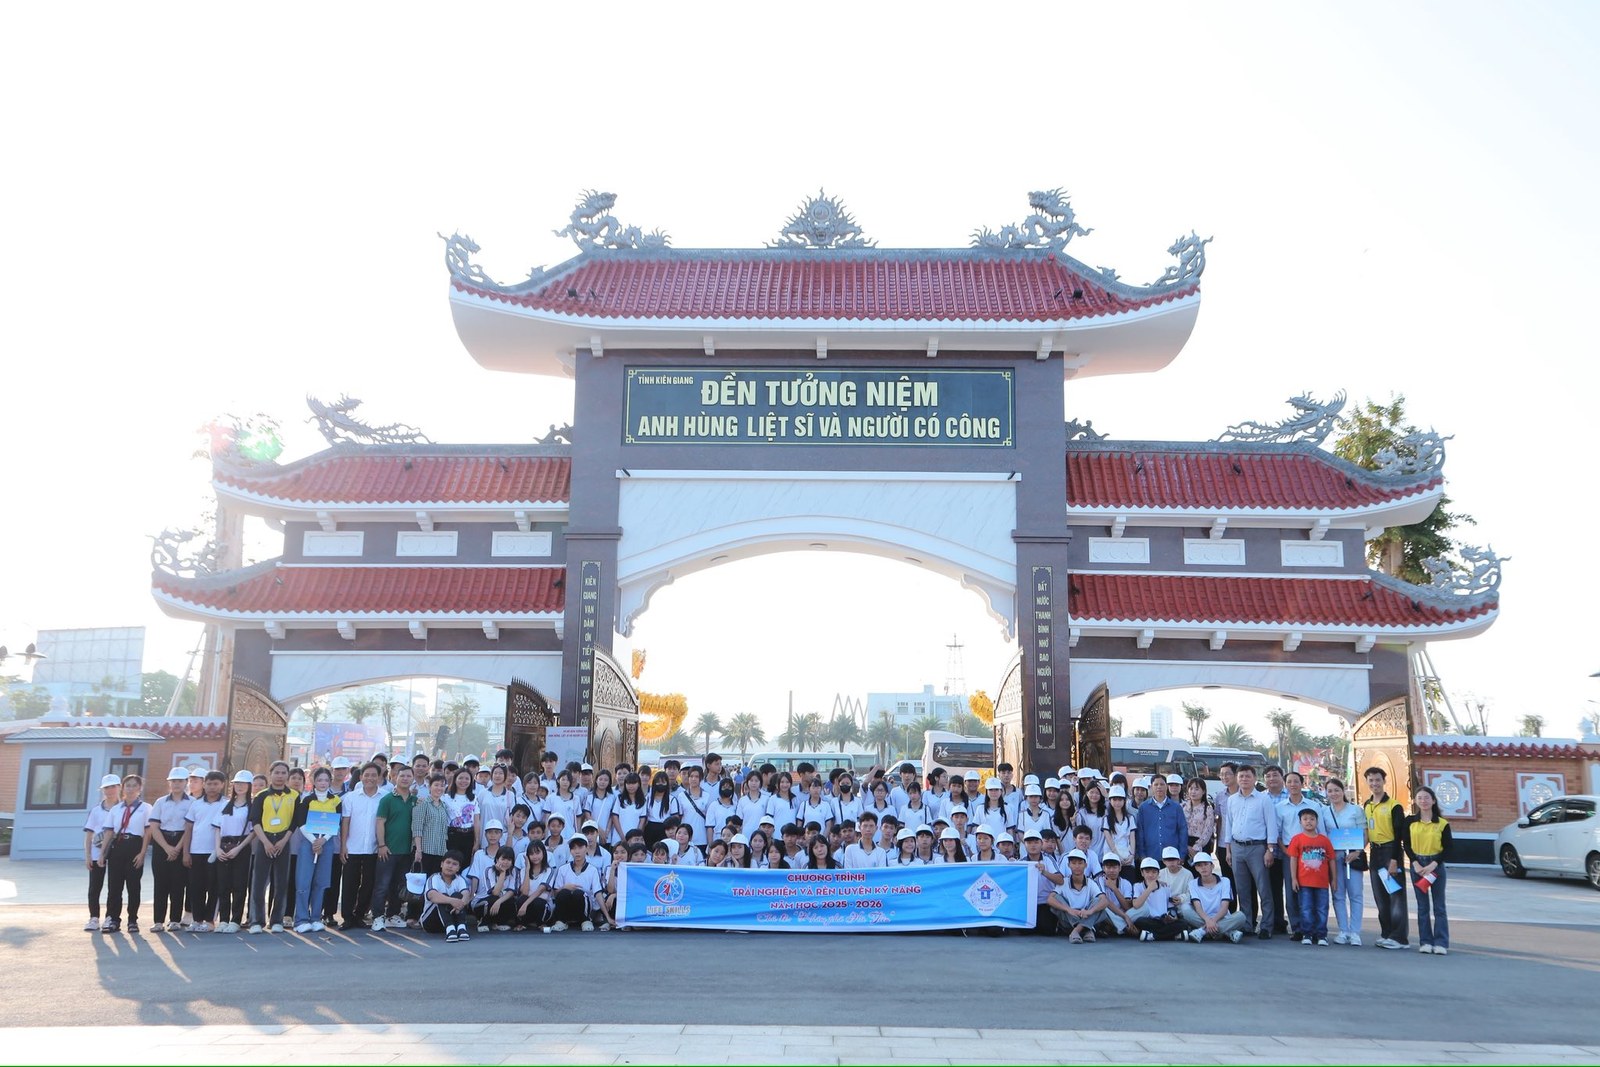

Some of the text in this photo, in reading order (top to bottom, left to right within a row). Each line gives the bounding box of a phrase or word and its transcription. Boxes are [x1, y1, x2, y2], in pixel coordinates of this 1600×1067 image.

[638, 375, 694, 385] TỈNH KIÊN GIANG
[700, 372, 938, 412] ĐỀN TƯỞNG NIỆM
[638, 411, 1000, 442] ANH HÙNG LIỆT SĨ VÀ NGƯỜI CÓ CÔNG
[585, 576, 596, 586] KIÊN
[1038, 580, 1047, 591] ĐẤT
[583, 591, 597, 600] GIANG
[1036, 611, 1051, 620] THANH
[1039, 653, 1049, 661] BAO
[1038, 693, 1051, 706] QUỐC
[1039, 711, 1052, 719] VONG
[787, 872, 865, 882] CHƯƠNG TRÌNH
[732, 886, 755, 896] TRẢI
[758, 886, 797, 898] NGHIỆM
[800, 886, 813, 896] VÀ
[874, 886, 889, 894] KỸ
[892, 885, 921, 894] NĂNG
[770, 900, 794, 909] NĂM
[646, 905, 664, 915] LIFE
